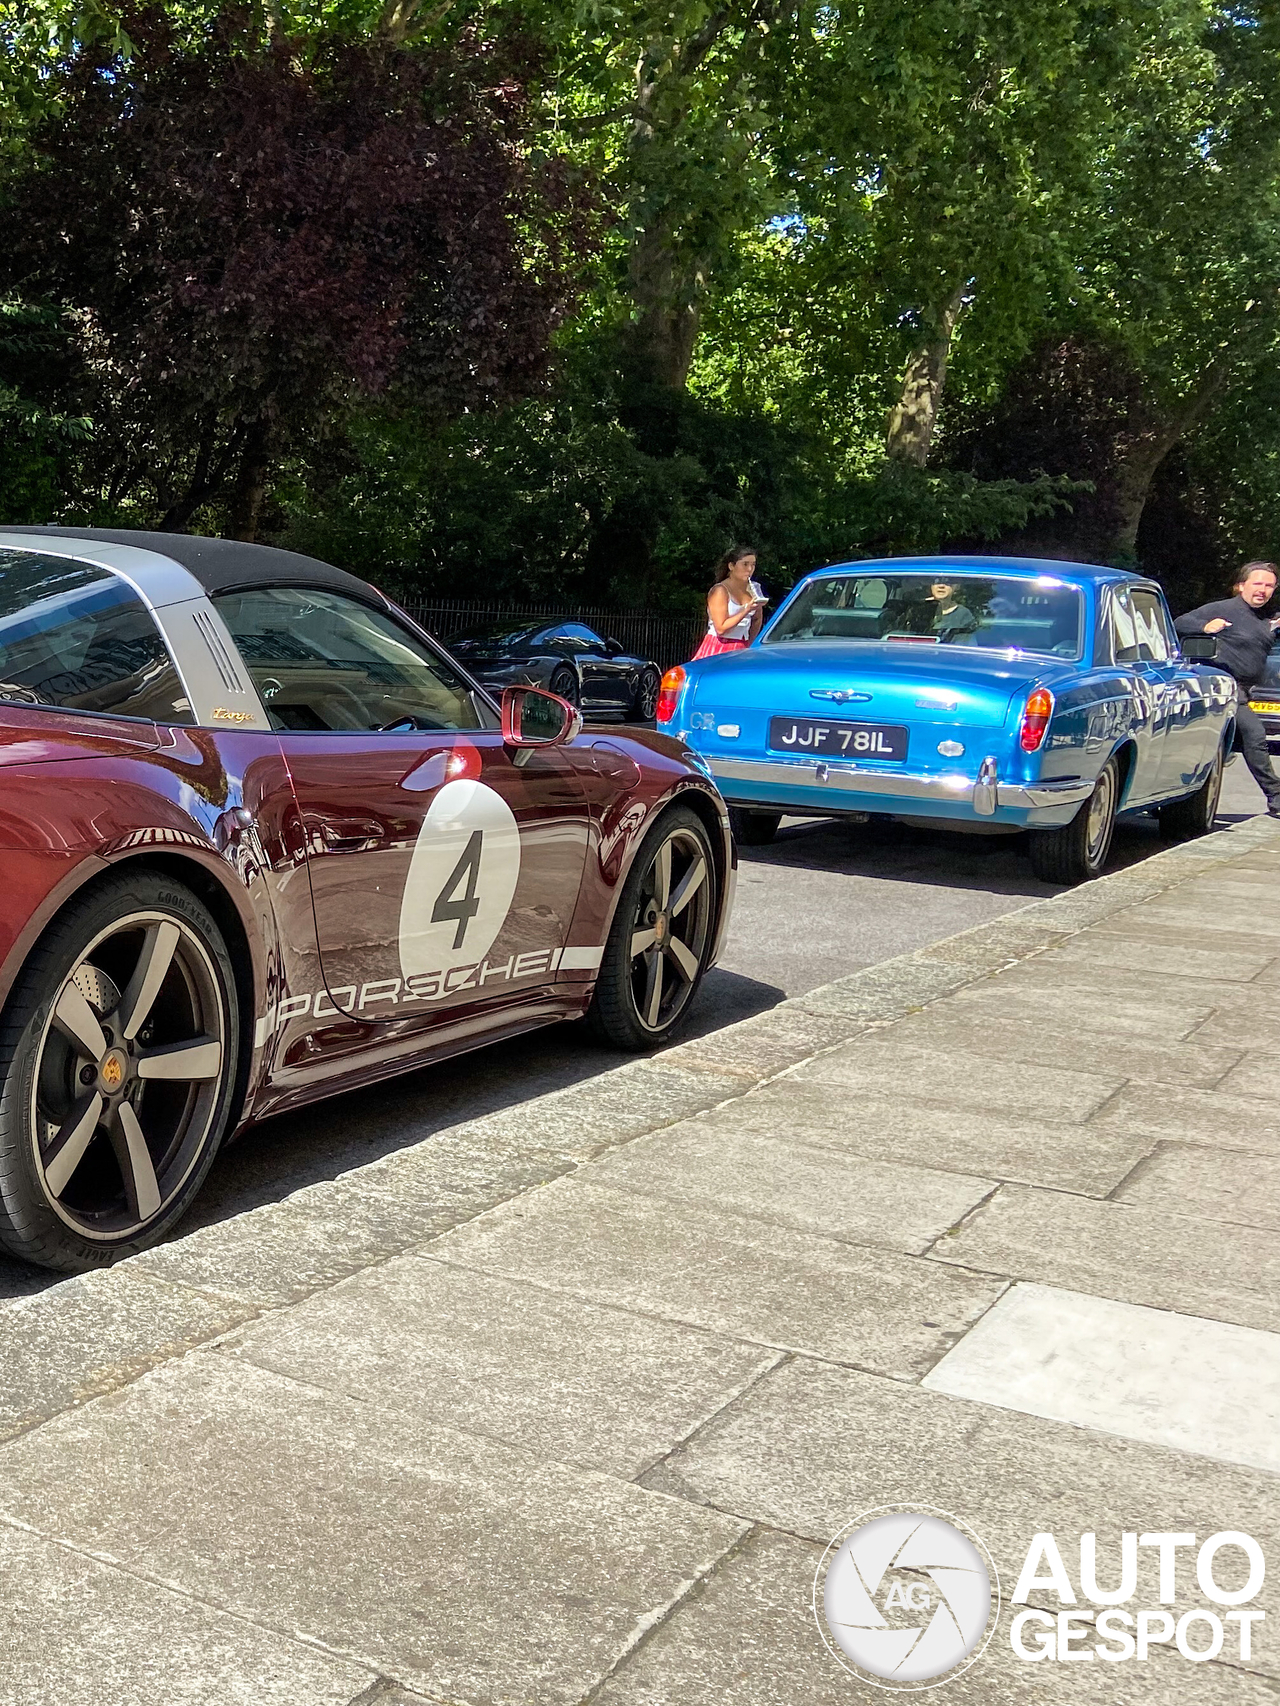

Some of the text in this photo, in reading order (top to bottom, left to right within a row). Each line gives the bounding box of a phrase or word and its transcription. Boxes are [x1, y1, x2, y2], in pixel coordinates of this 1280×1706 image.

[212, 707, 256, 724] Targa
[782, 725, 893, 753] JJF 781L
[430, 830, 484, 950] 4
[157, 891, 213, 936] GOODYEAR
[275, 949, 551, 1031] PORSCHE
[76, 1245, 115, 1261] EAGLE
